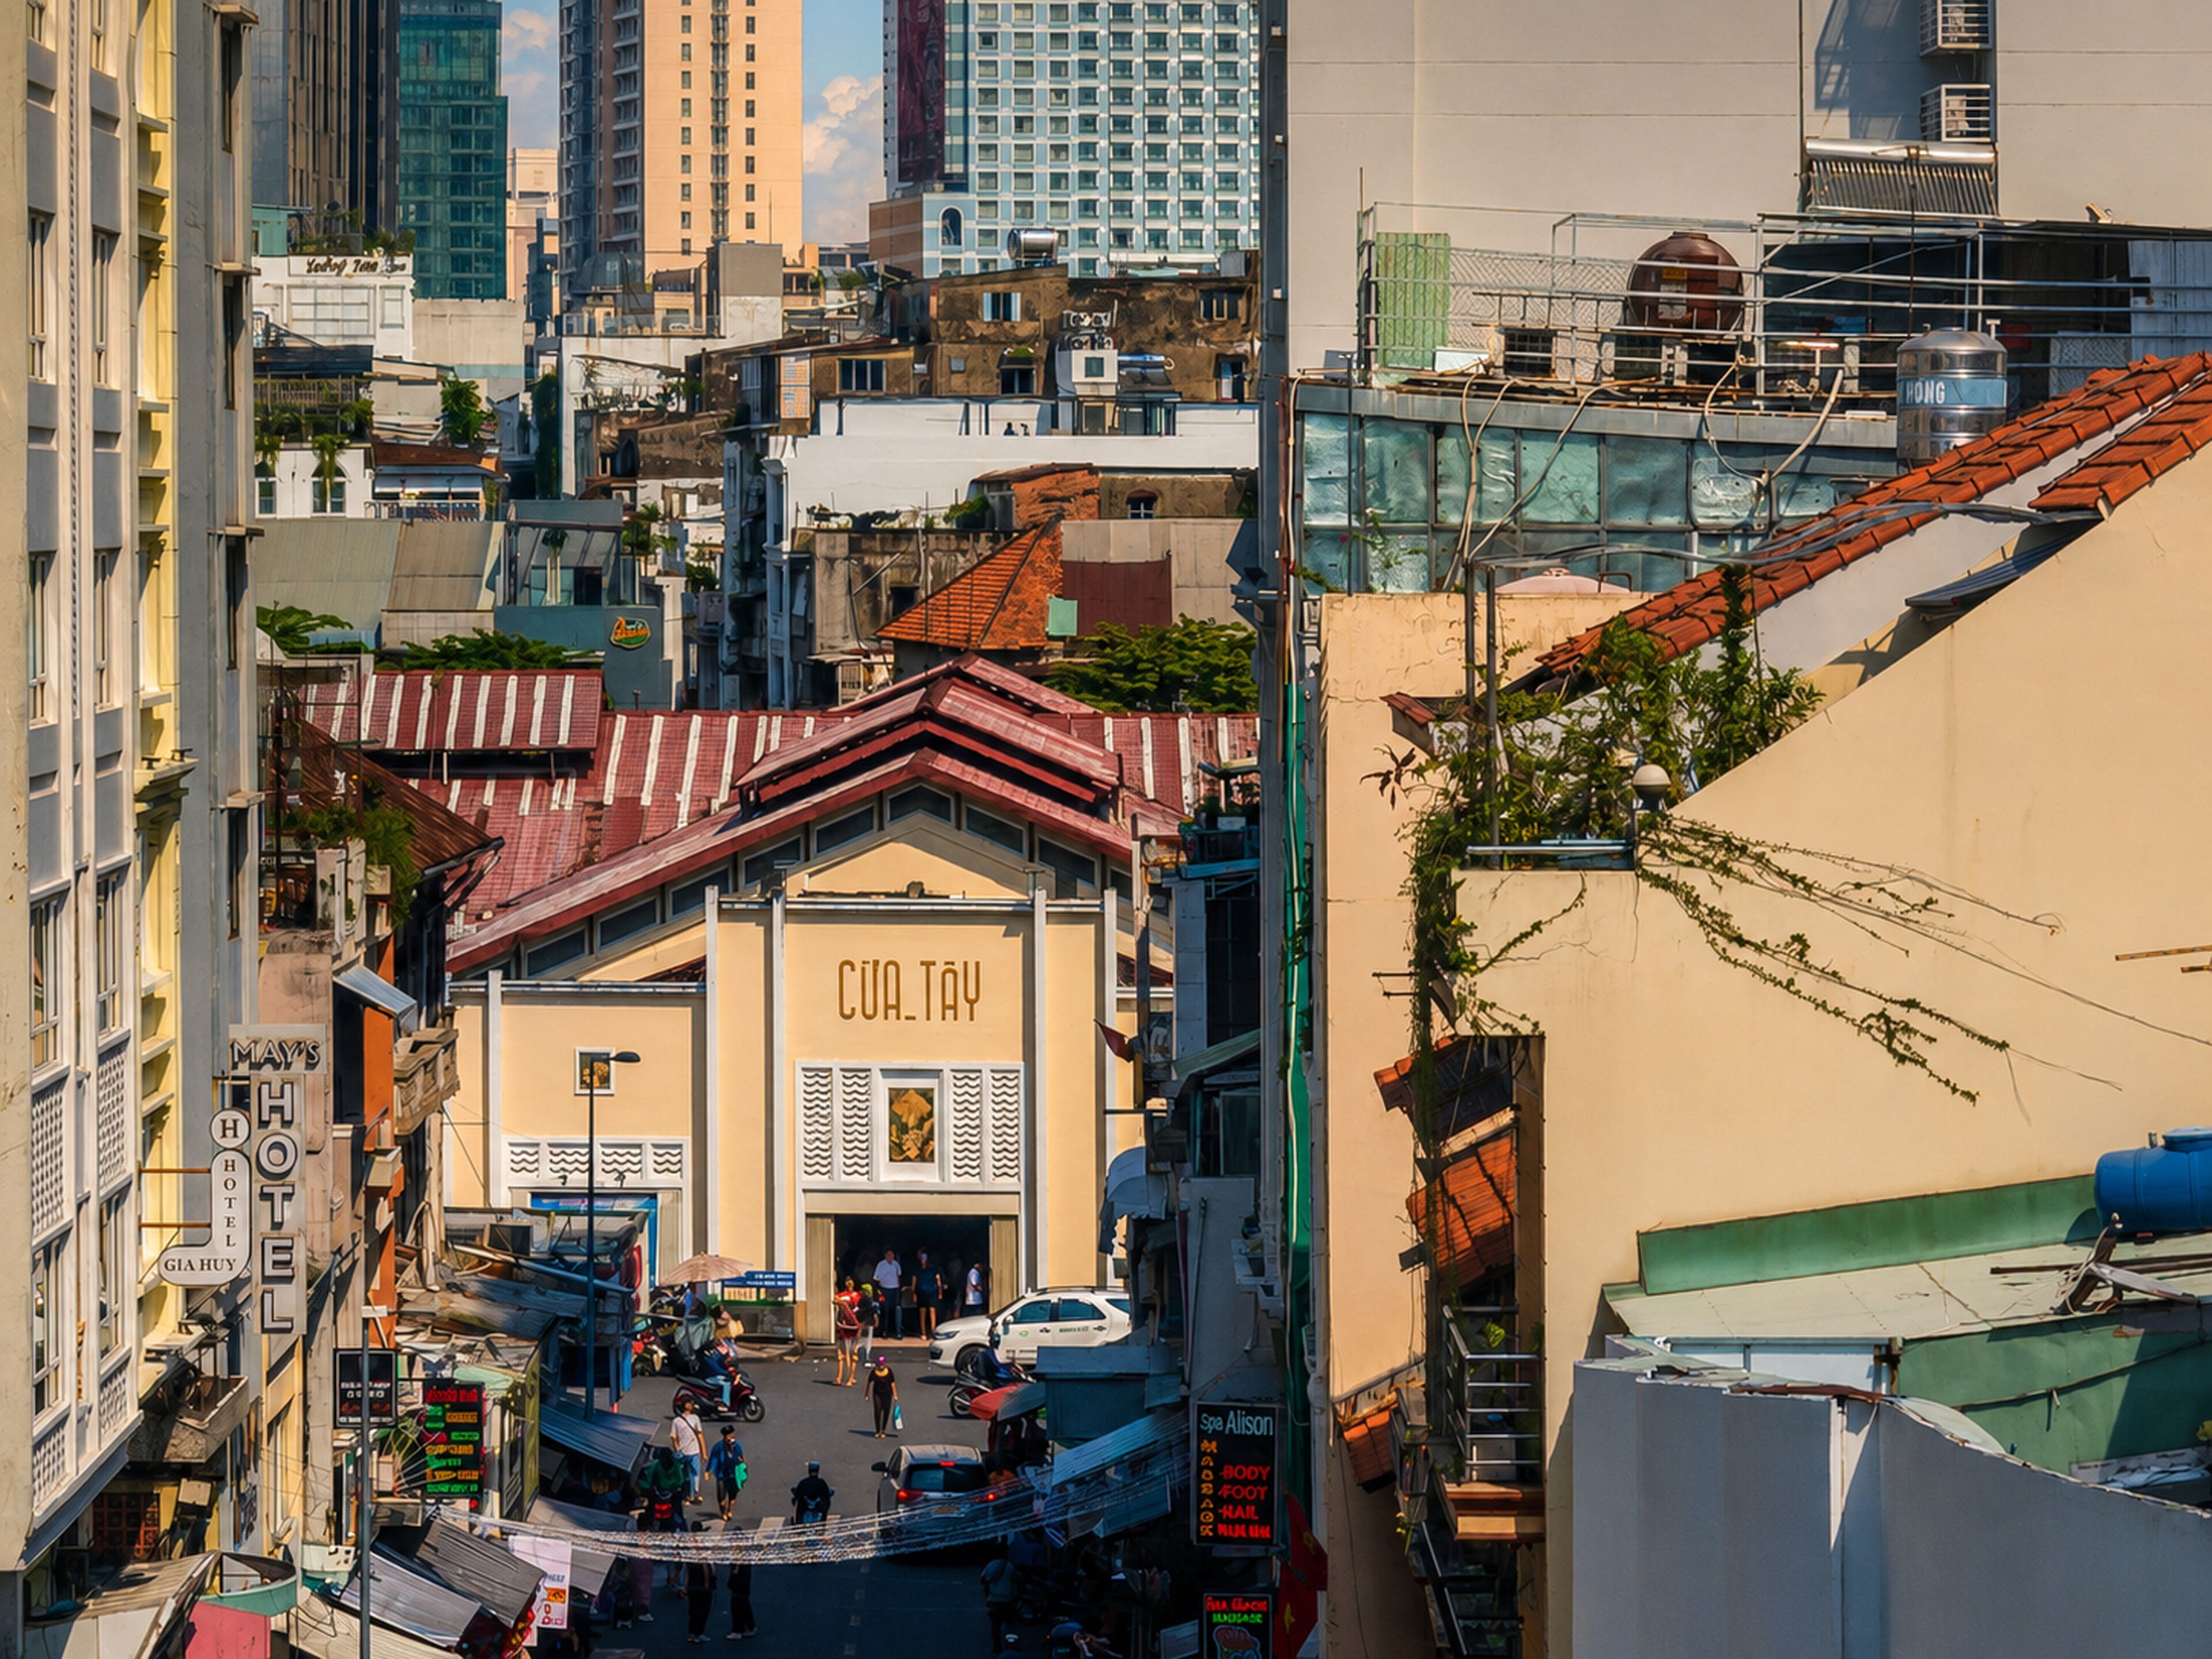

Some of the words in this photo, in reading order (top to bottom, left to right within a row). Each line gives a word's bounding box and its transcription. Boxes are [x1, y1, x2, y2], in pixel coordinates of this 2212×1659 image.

[232, 1039, 320, 1068] MAY'S
[220, 1118, 240, 1139] H
[224, 1158, 237, 1248] HOTEL
[257, 1081, 298, 1331] HOTEL
[164, 1258, 196, 1272] GIA
[199, 1258, 237, 1272] HUY
[1199, 1412, 1224, 1433] Spa
[1225, 1410, 1274, 1436] Alison
